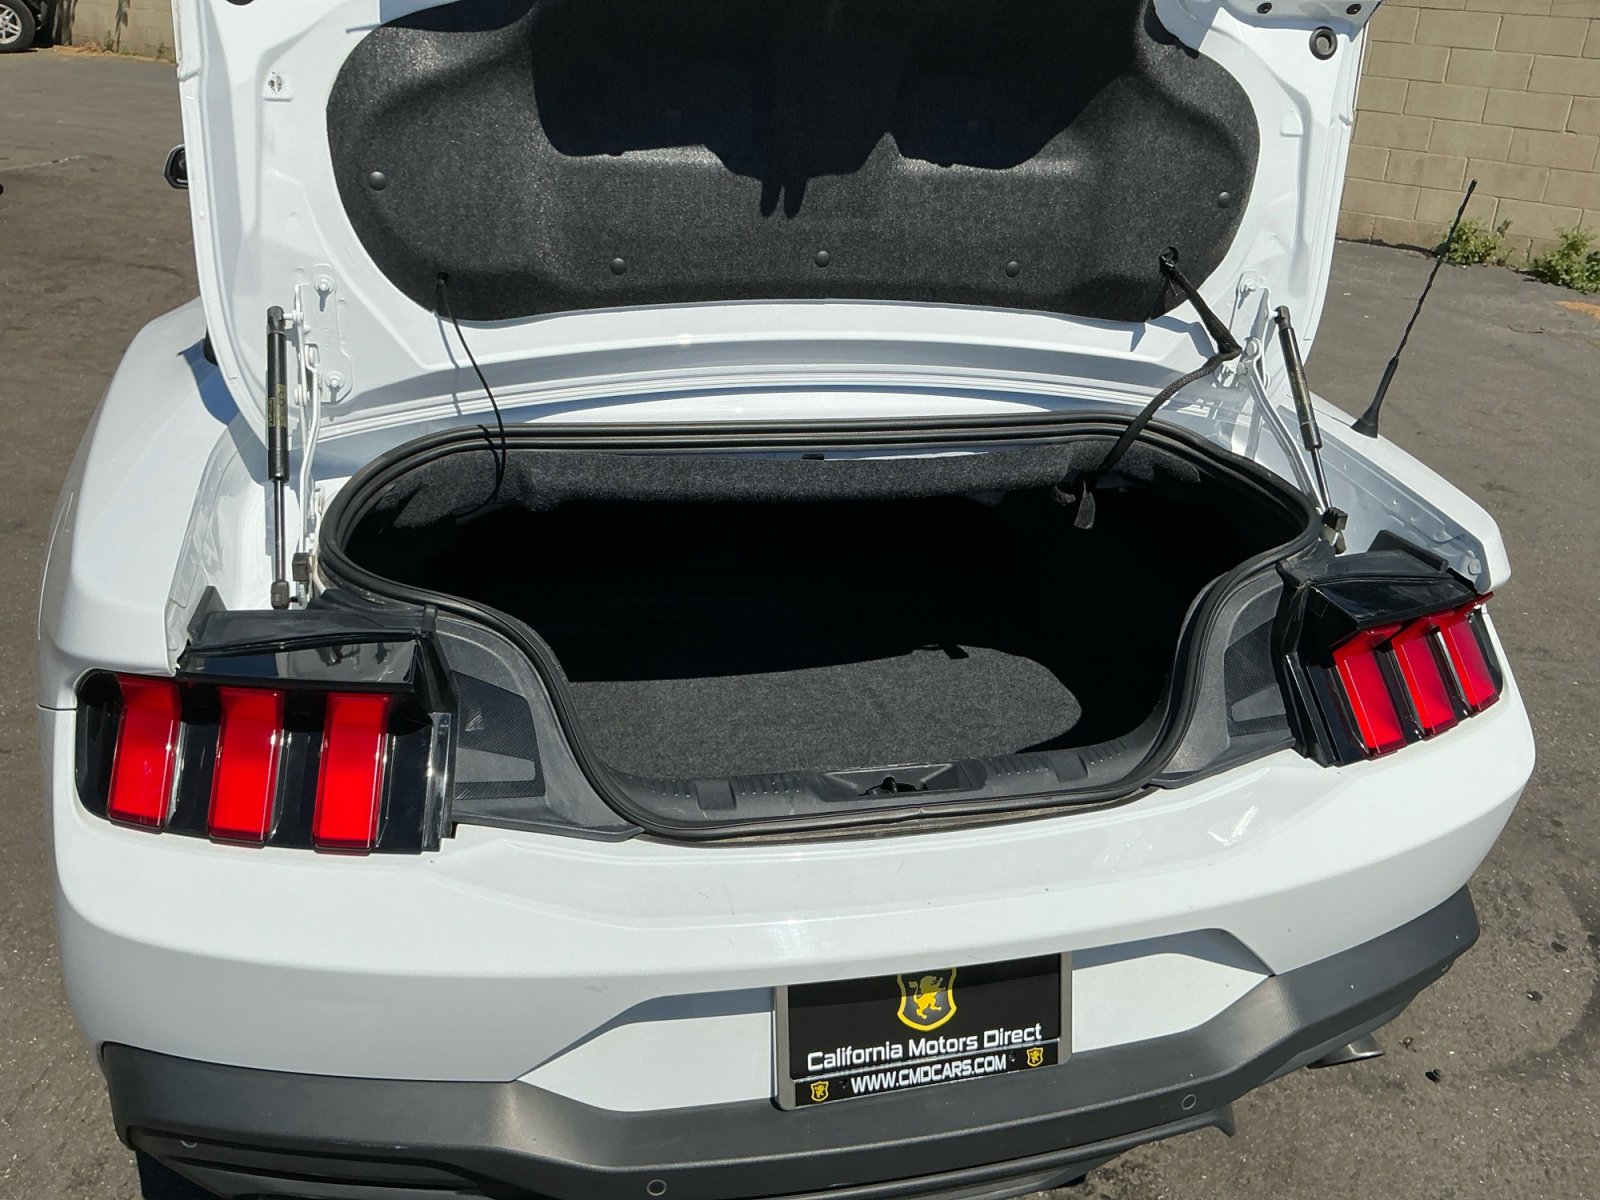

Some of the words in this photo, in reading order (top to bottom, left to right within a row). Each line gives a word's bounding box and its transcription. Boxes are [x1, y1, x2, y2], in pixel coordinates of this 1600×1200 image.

[807, 1041, 903, 1072] California
[908, 1035, 978, 1057] Motors
[983, 1022, 1042, 1048] Direct
[850, 1054, 1007, 1094] WWW.CMDCARS.COM
